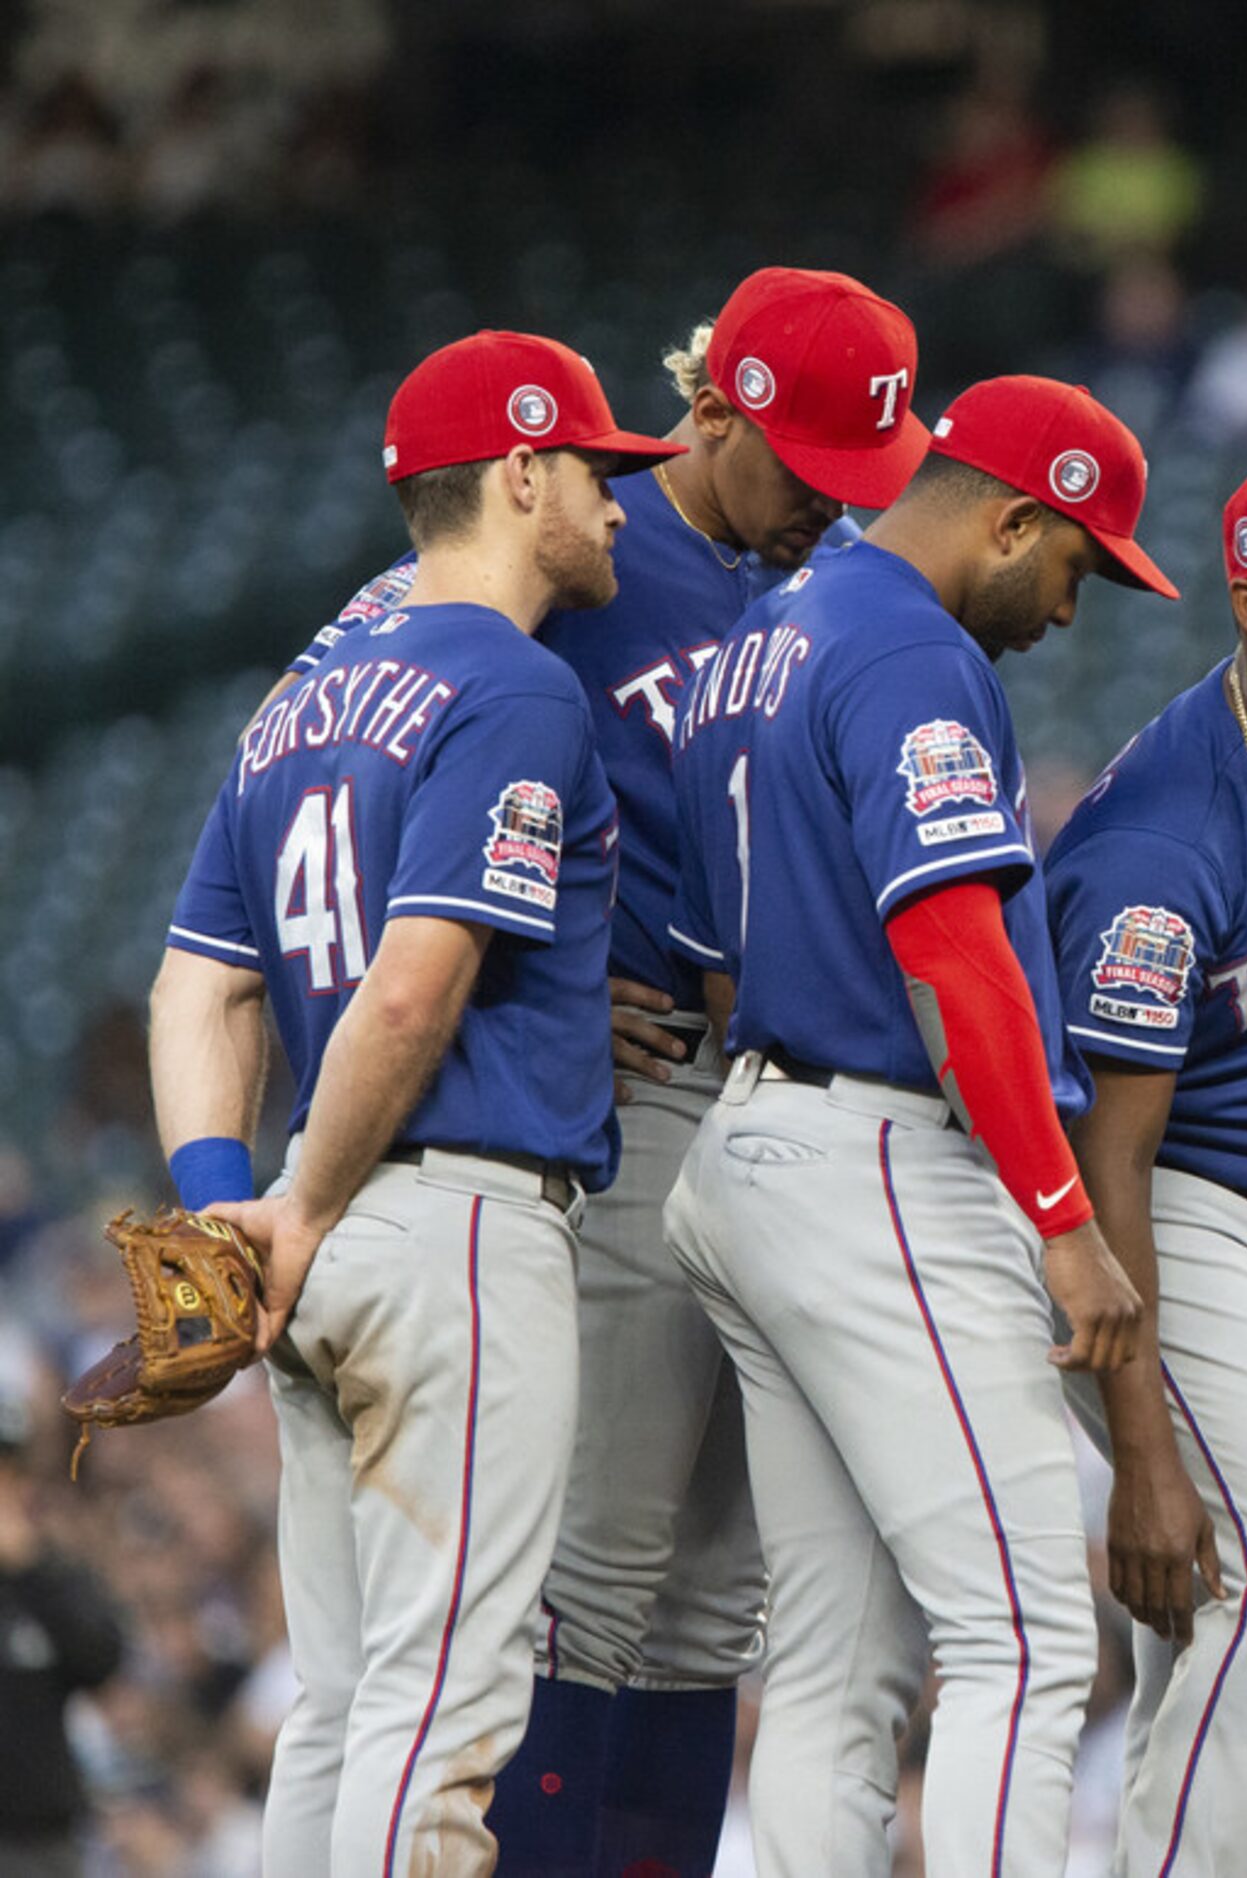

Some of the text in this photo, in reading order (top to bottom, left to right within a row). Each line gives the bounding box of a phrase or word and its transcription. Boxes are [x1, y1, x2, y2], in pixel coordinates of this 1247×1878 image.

[869, 367, 908, 430] T
[236, 659, 455, 797] FORSYTHE
[918, 783, 949, 802] FINAL
[274, 777, 369, 994] 41
[727, 751, 750, 950] 1
[1105, 964, 1137, 979] FINAL
